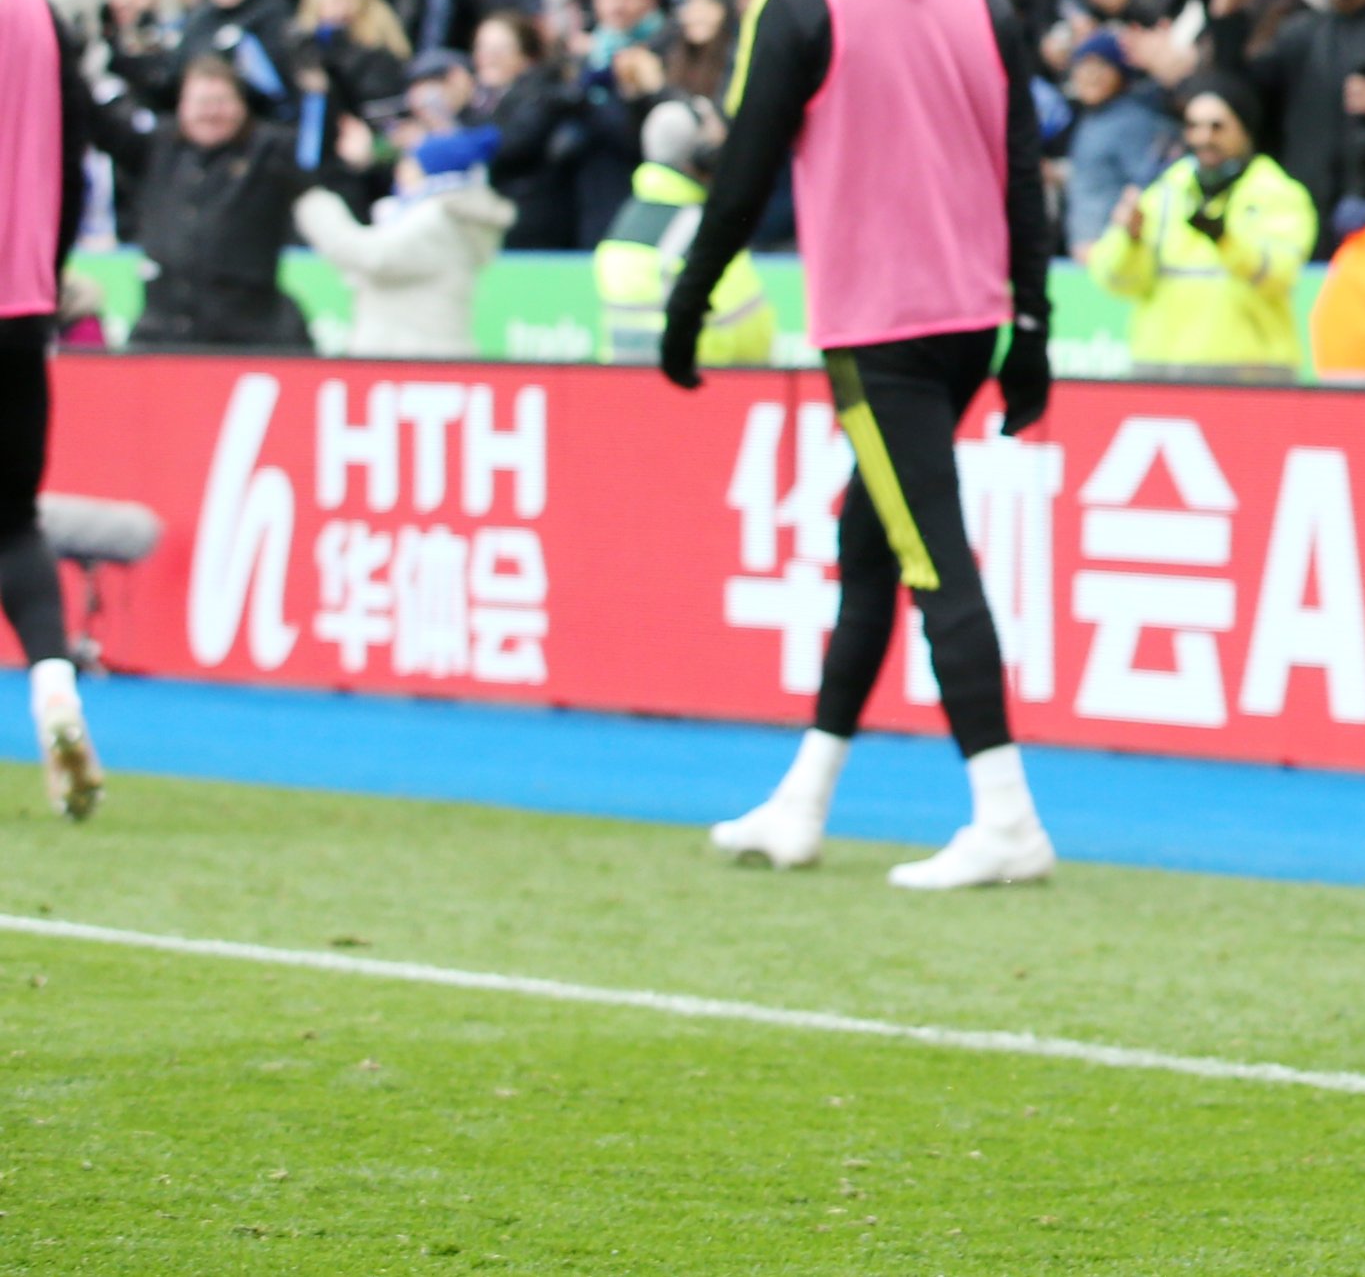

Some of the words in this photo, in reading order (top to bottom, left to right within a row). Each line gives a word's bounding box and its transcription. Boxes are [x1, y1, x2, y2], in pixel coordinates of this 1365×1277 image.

[316, 378, 546, 518] HTH
[313, 520, 547, 684] 华体会
